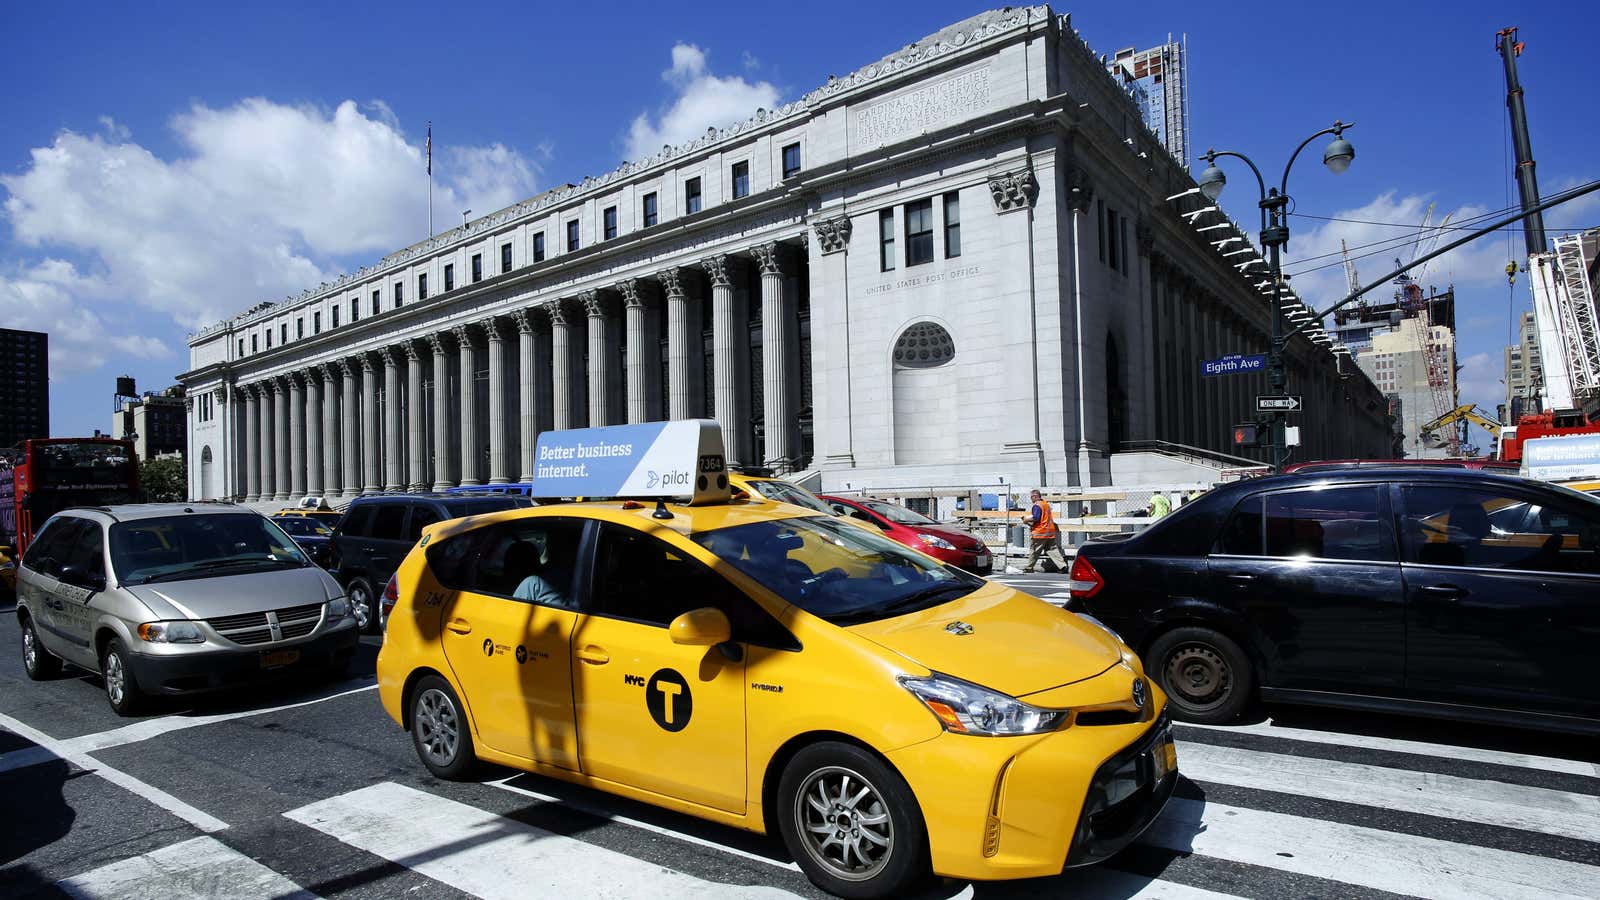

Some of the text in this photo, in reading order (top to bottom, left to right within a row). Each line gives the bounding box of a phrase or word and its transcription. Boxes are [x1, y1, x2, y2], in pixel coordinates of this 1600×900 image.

[866, 266, 979, 295] UNITED STATES POST OFFICE
[1206, 360, 1260, 373] Eighth Ave
[540, 441, 632, 460] Better business
[538, 463, 589, 478] internet.
[700, 458, 721, 470] 7364
[662, 470, 689, 488] pilot
[624, 674, 682, 724] NYC T
